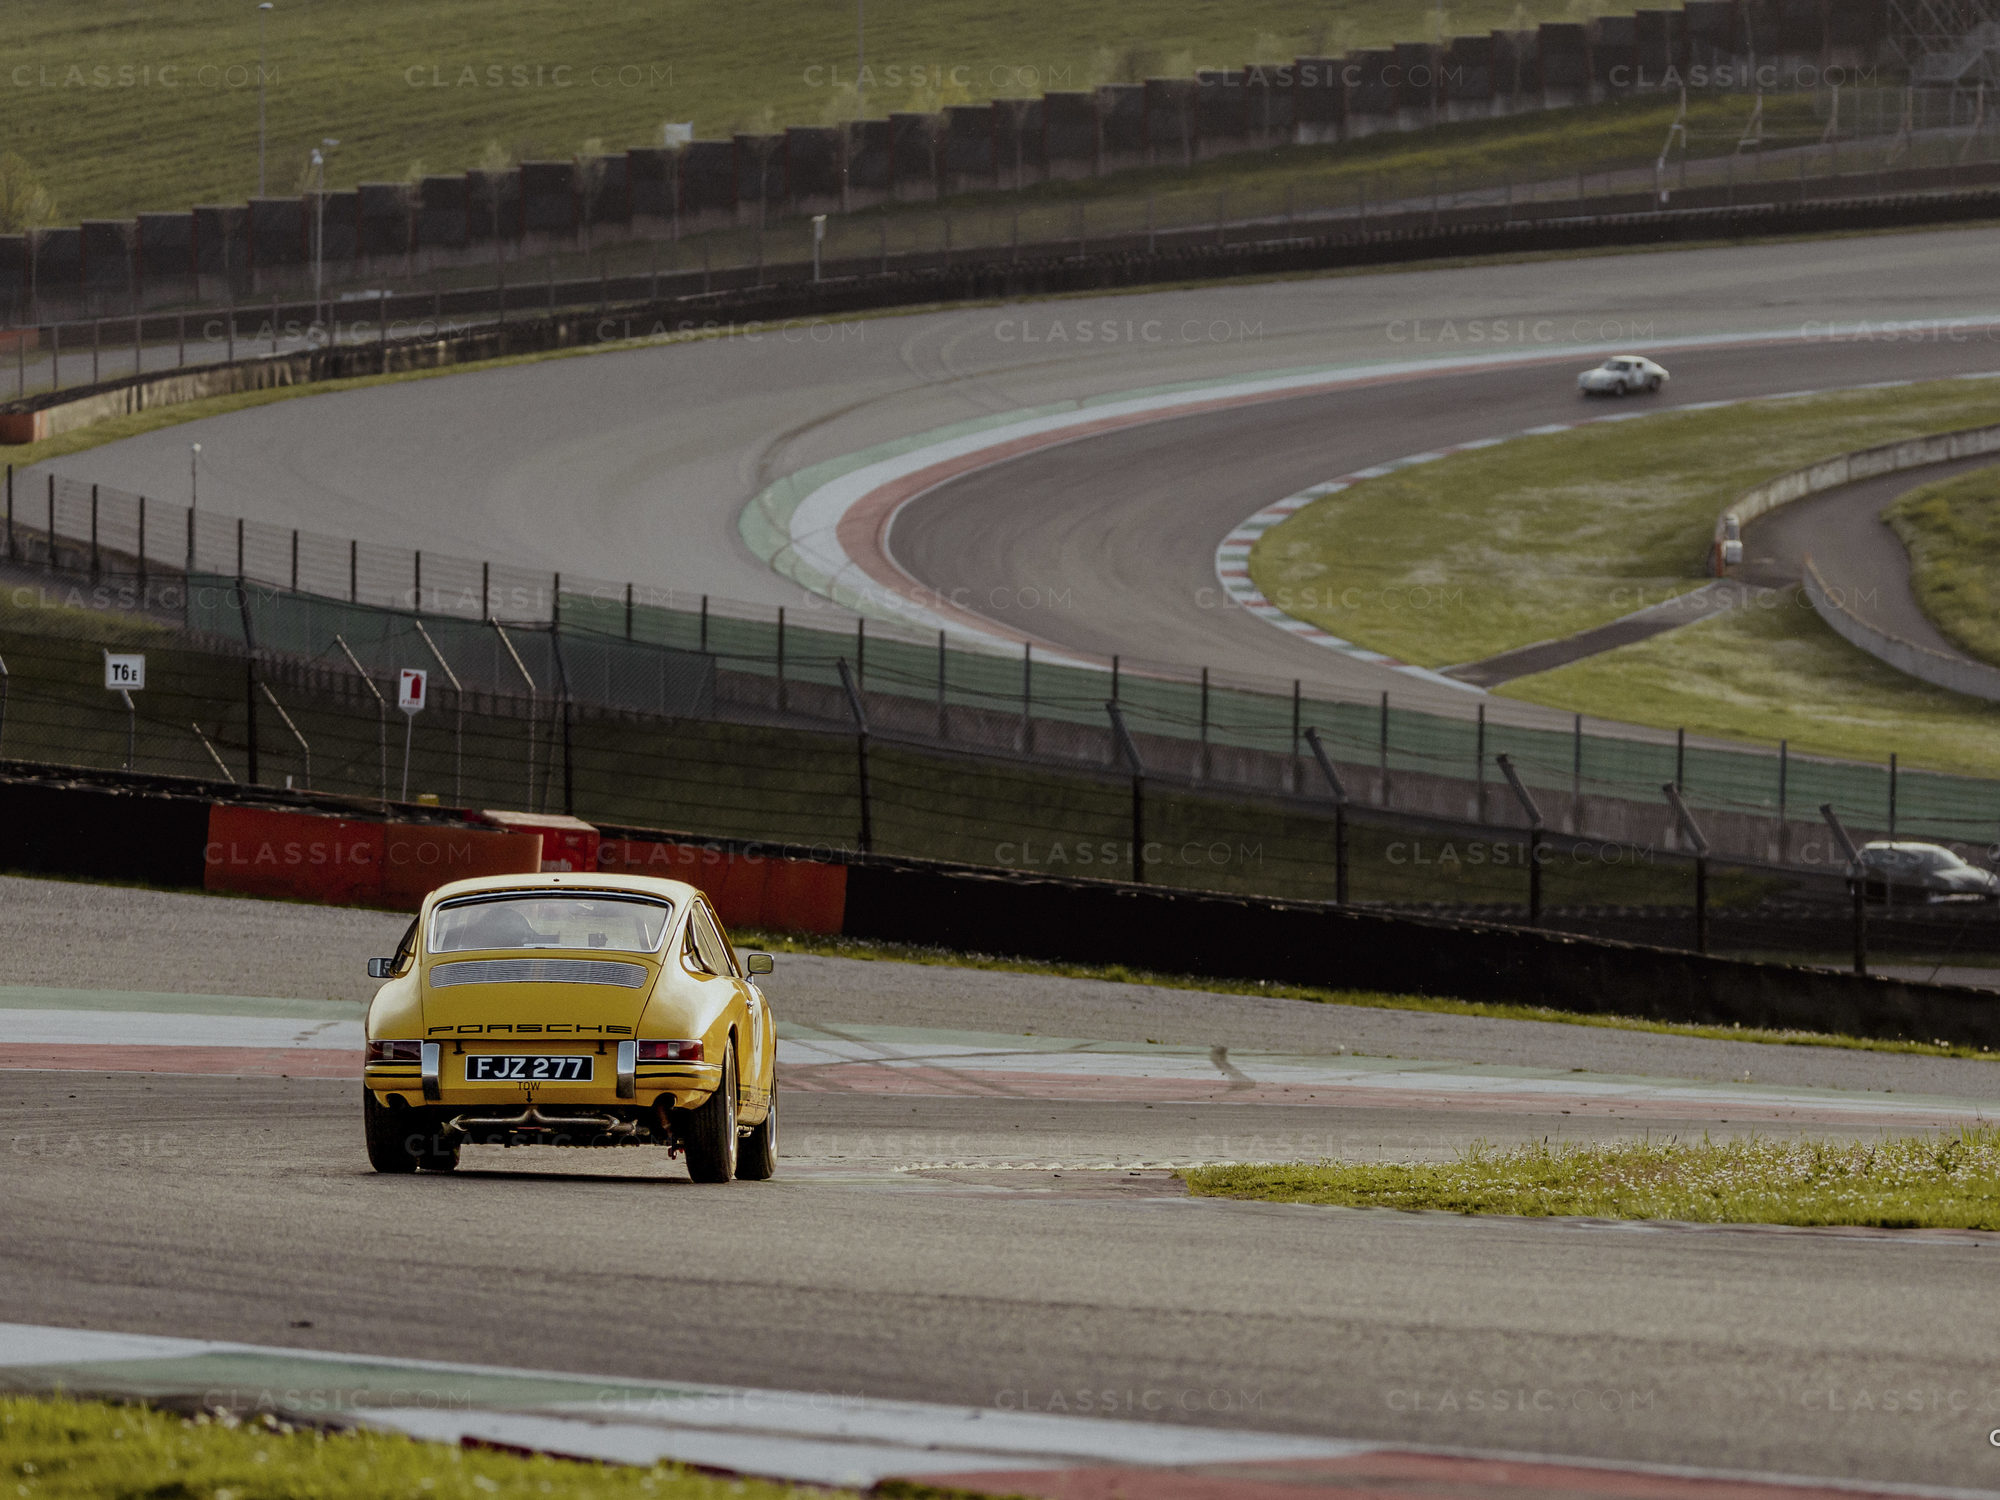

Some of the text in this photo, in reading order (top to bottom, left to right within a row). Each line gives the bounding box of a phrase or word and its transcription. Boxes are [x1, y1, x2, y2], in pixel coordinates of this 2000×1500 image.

[428, 1024, 632, 1036] PORSCHE
[476, 1057, 583, 1079] FJZ 277
[516, 1081, 541, 1091] TOW
